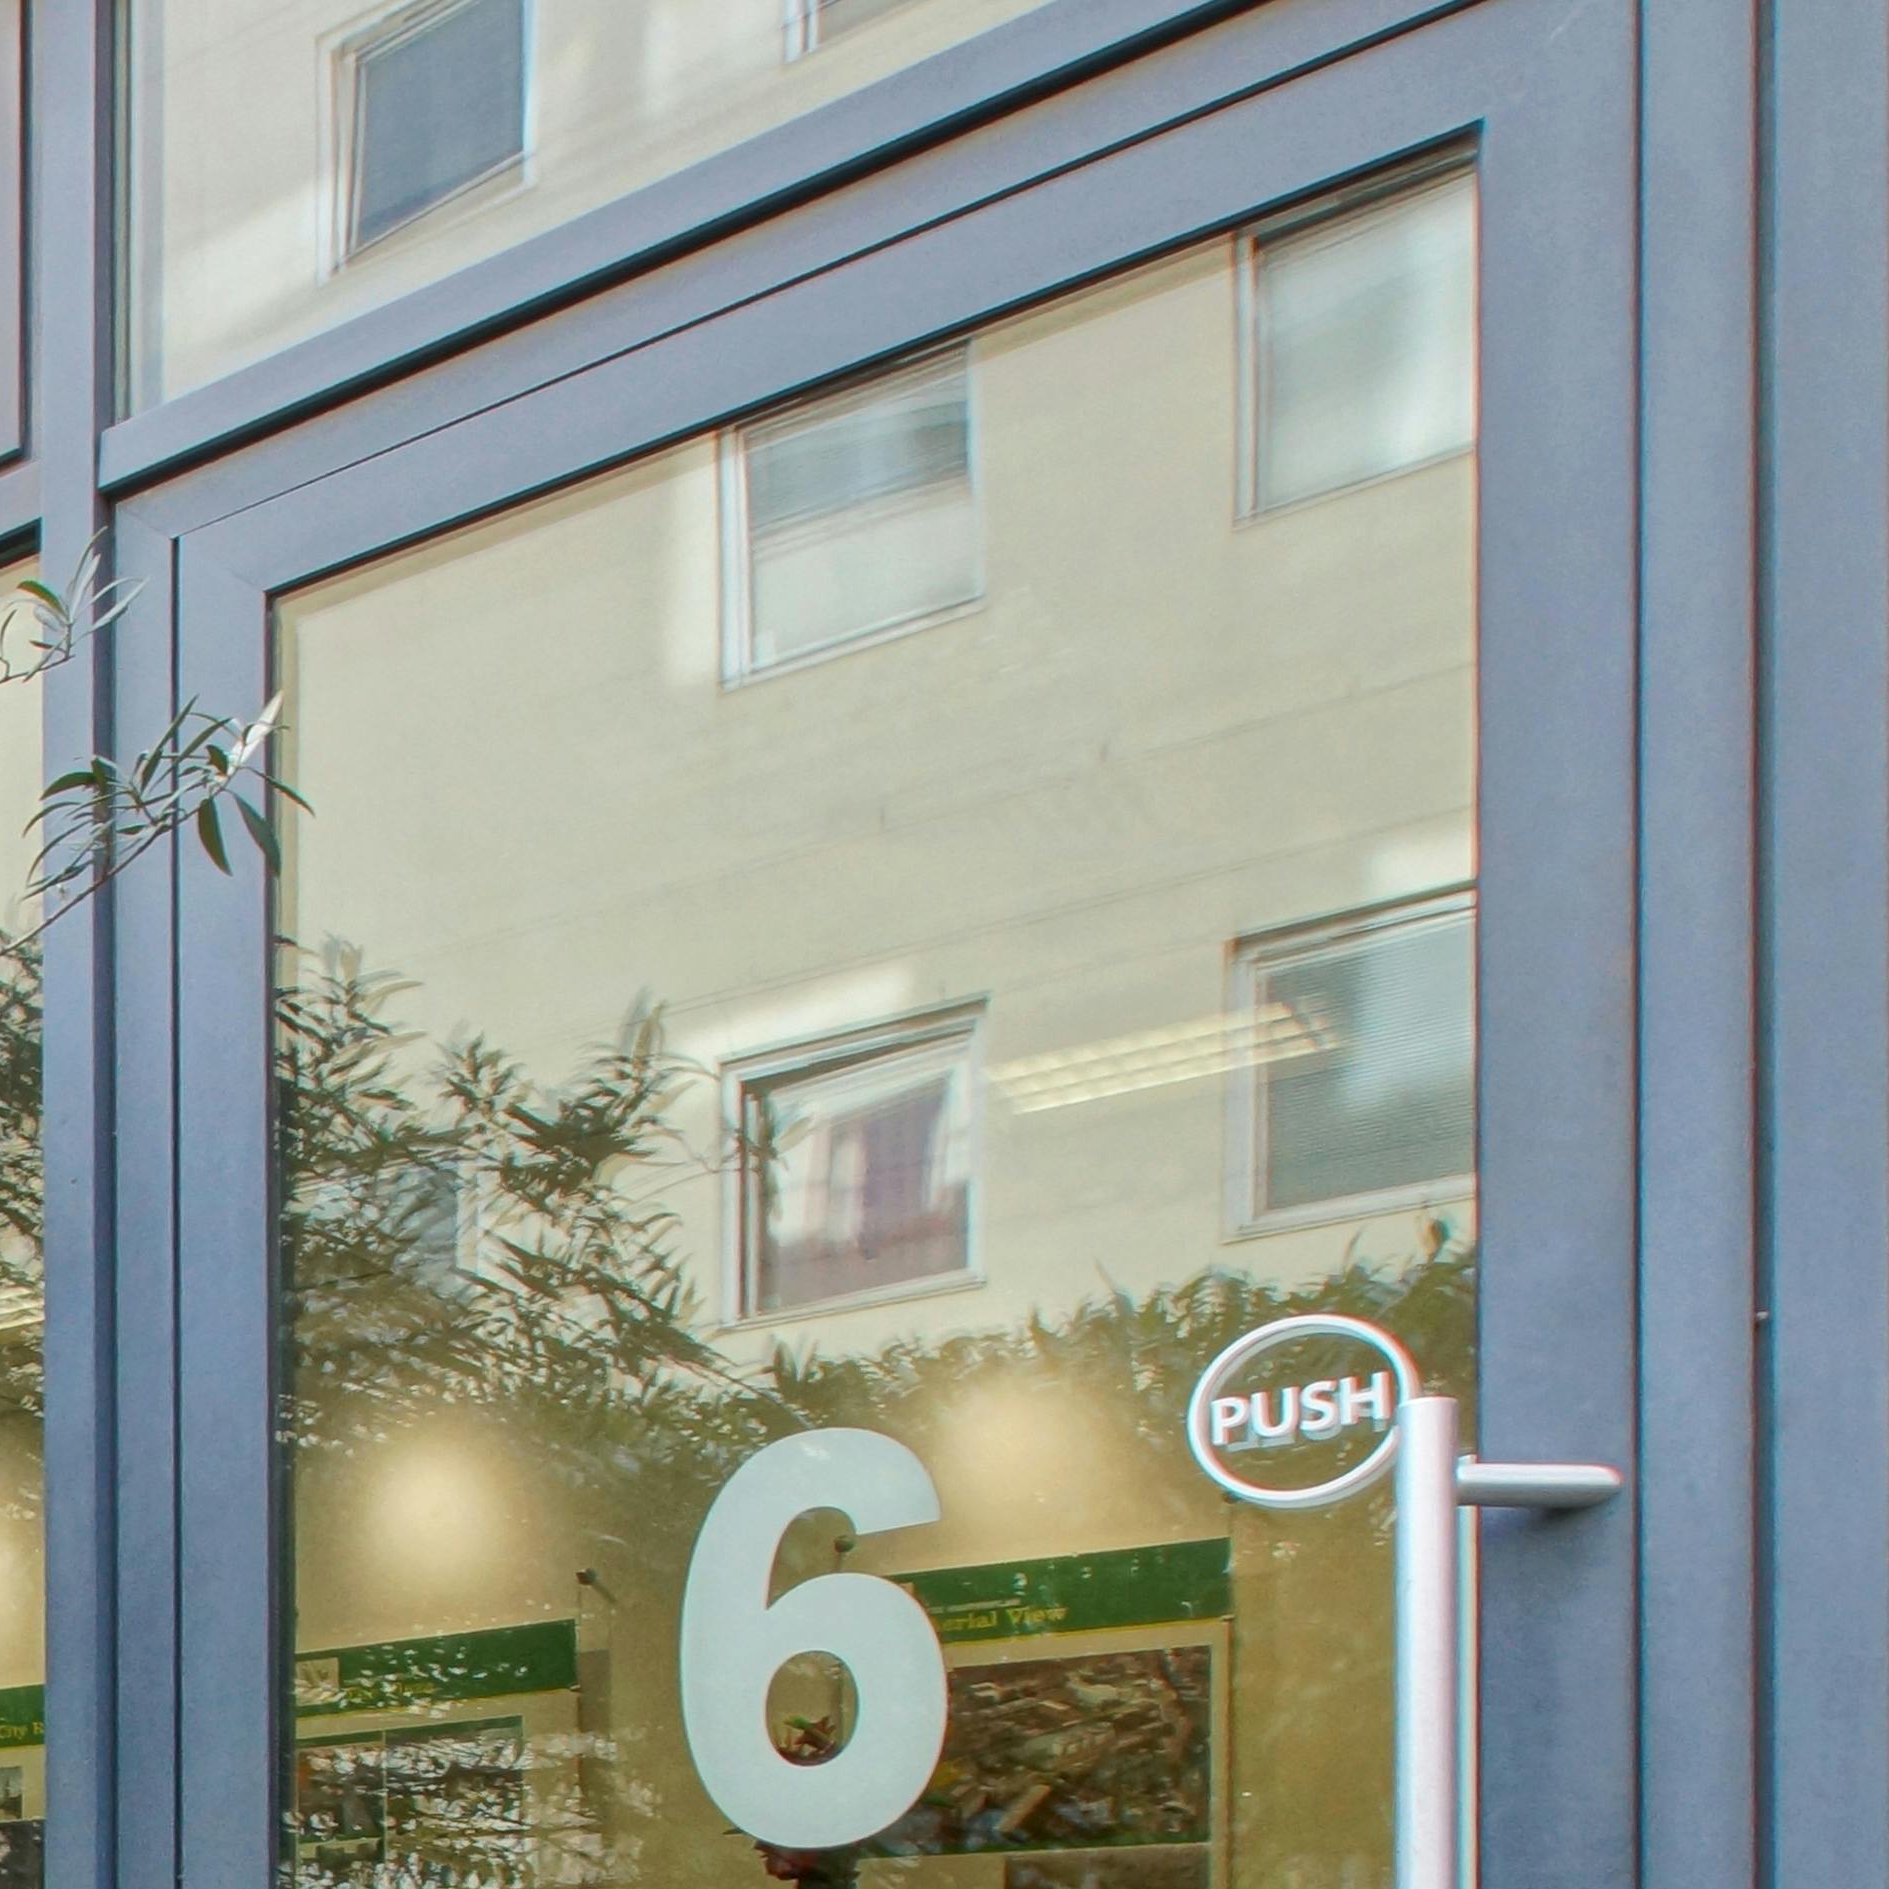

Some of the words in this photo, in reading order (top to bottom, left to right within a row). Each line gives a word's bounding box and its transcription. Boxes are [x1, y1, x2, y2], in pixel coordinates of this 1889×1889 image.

[1211, 1371, 1391, 1446] PUSH
[681, 1427, 948, 1848] 6
[937, 1611, 996, 1631] erial
[1007, 1606, 1068, 1626] View
